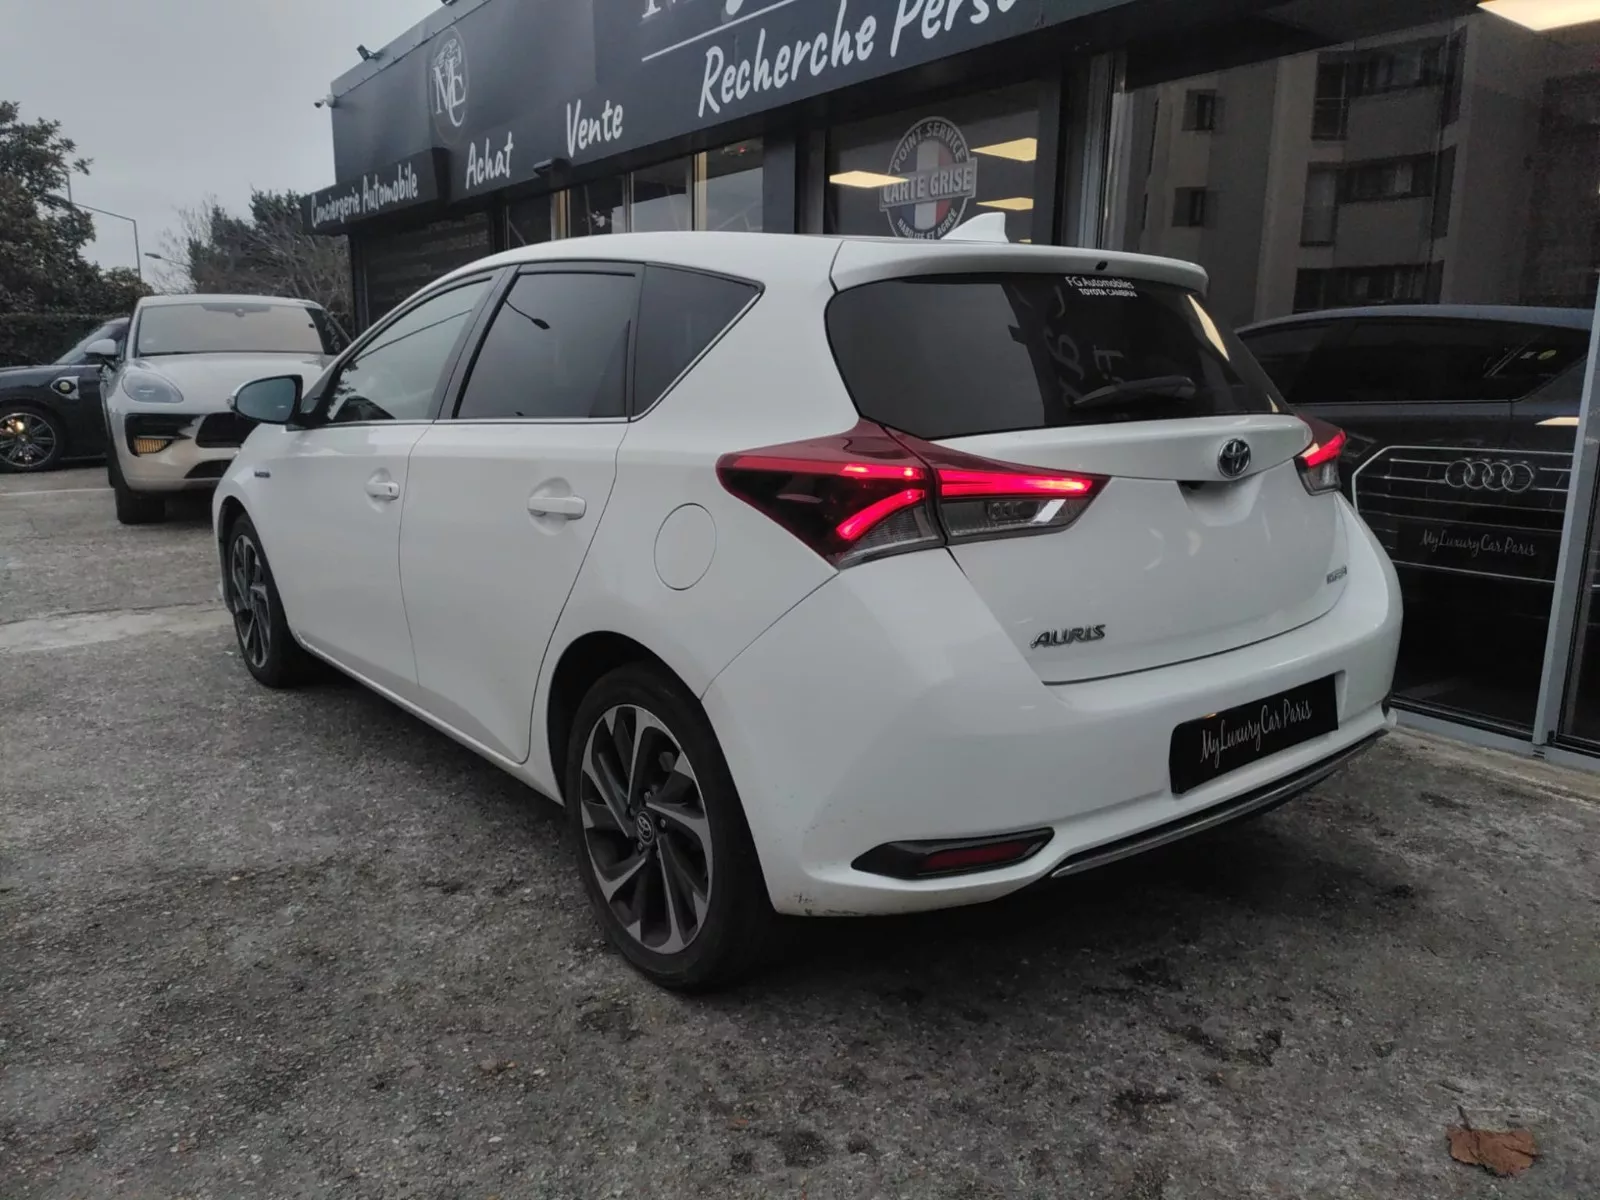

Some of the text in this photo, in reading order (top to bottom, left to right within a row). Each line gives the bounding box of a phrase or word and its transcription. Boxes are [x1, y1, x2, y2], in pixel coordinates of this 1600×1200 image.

[698, 0, 877, 117] Recherche
[566, 99, 624, 158] Vente
[893, 122, 966, 172] POINT SERVICE
[465, 131, 514, 190] Achat
[930, 168, 970, 196] GRISE
[311, 161, 419, 229] Conciergerie Automobile
[1078, 288, 1107, 296] TOYOTA
[1030, 624, 1107, 649] AURIS
